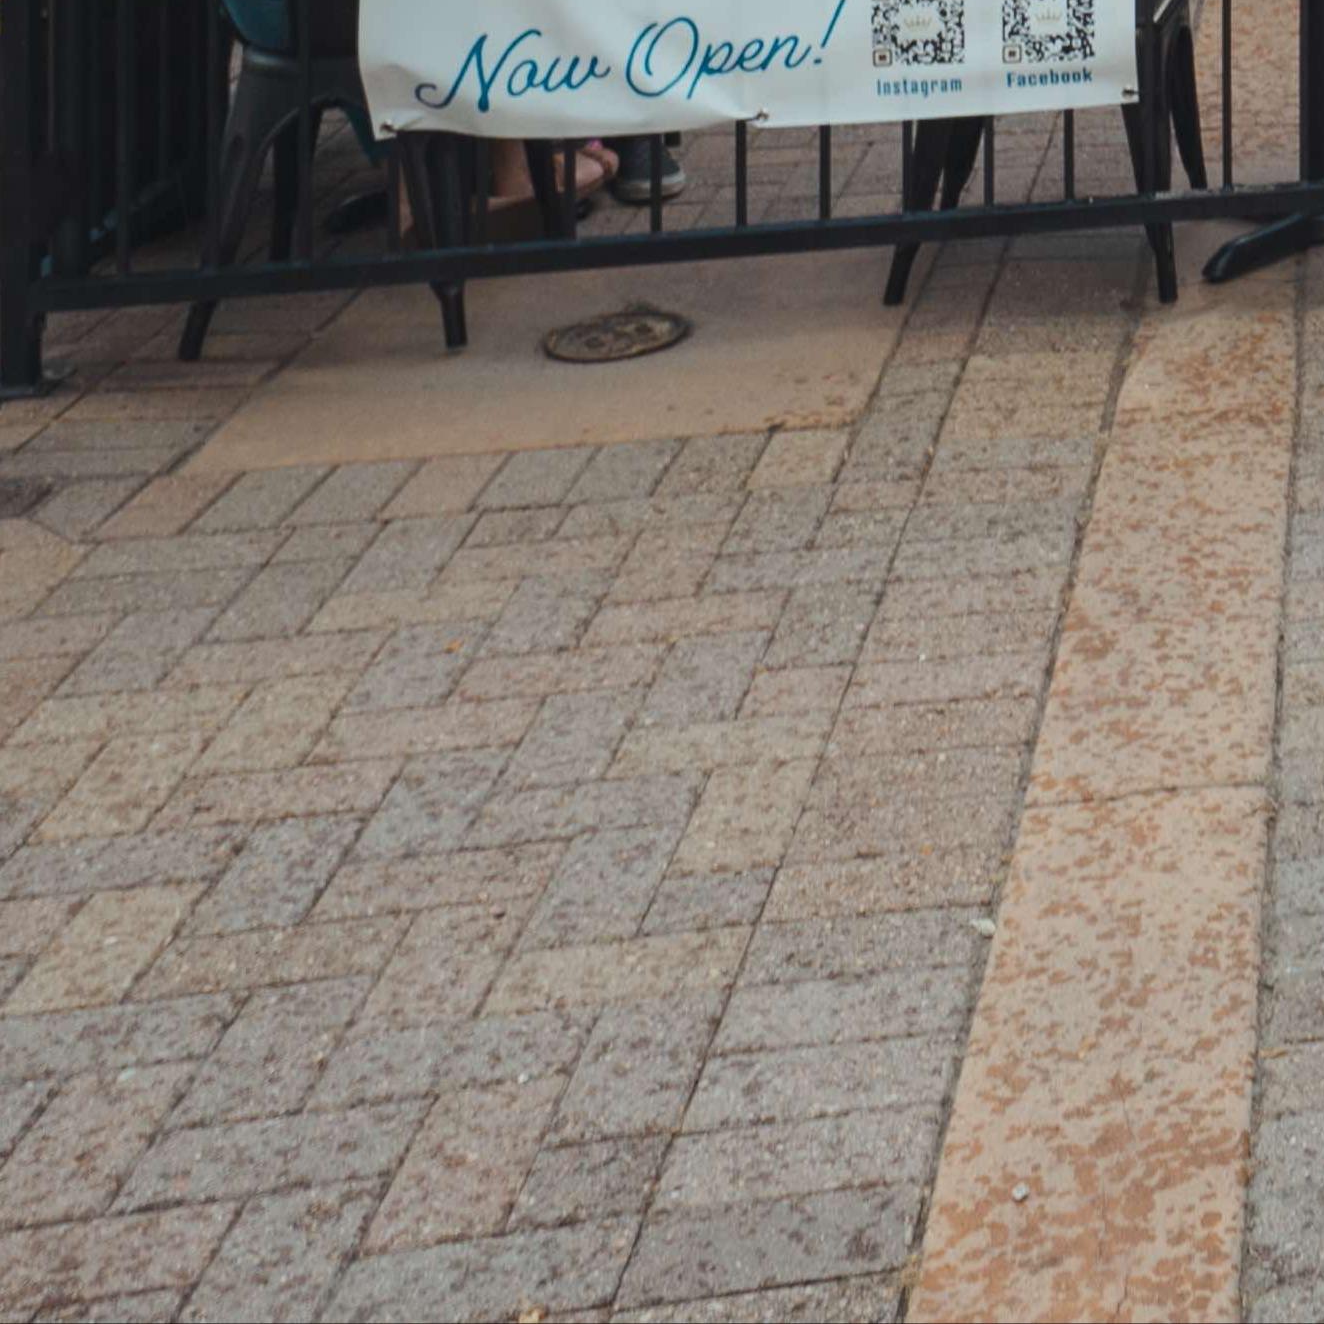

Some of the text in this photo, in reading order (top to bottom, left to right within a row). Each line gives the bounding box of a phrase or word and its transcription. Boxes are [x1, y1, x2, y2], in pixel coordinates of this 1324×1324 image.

[415, 29, 610, 113] Now
[1006, 67, 1093, 88] Facebook
[876, 78, 963, 98] Instagram
